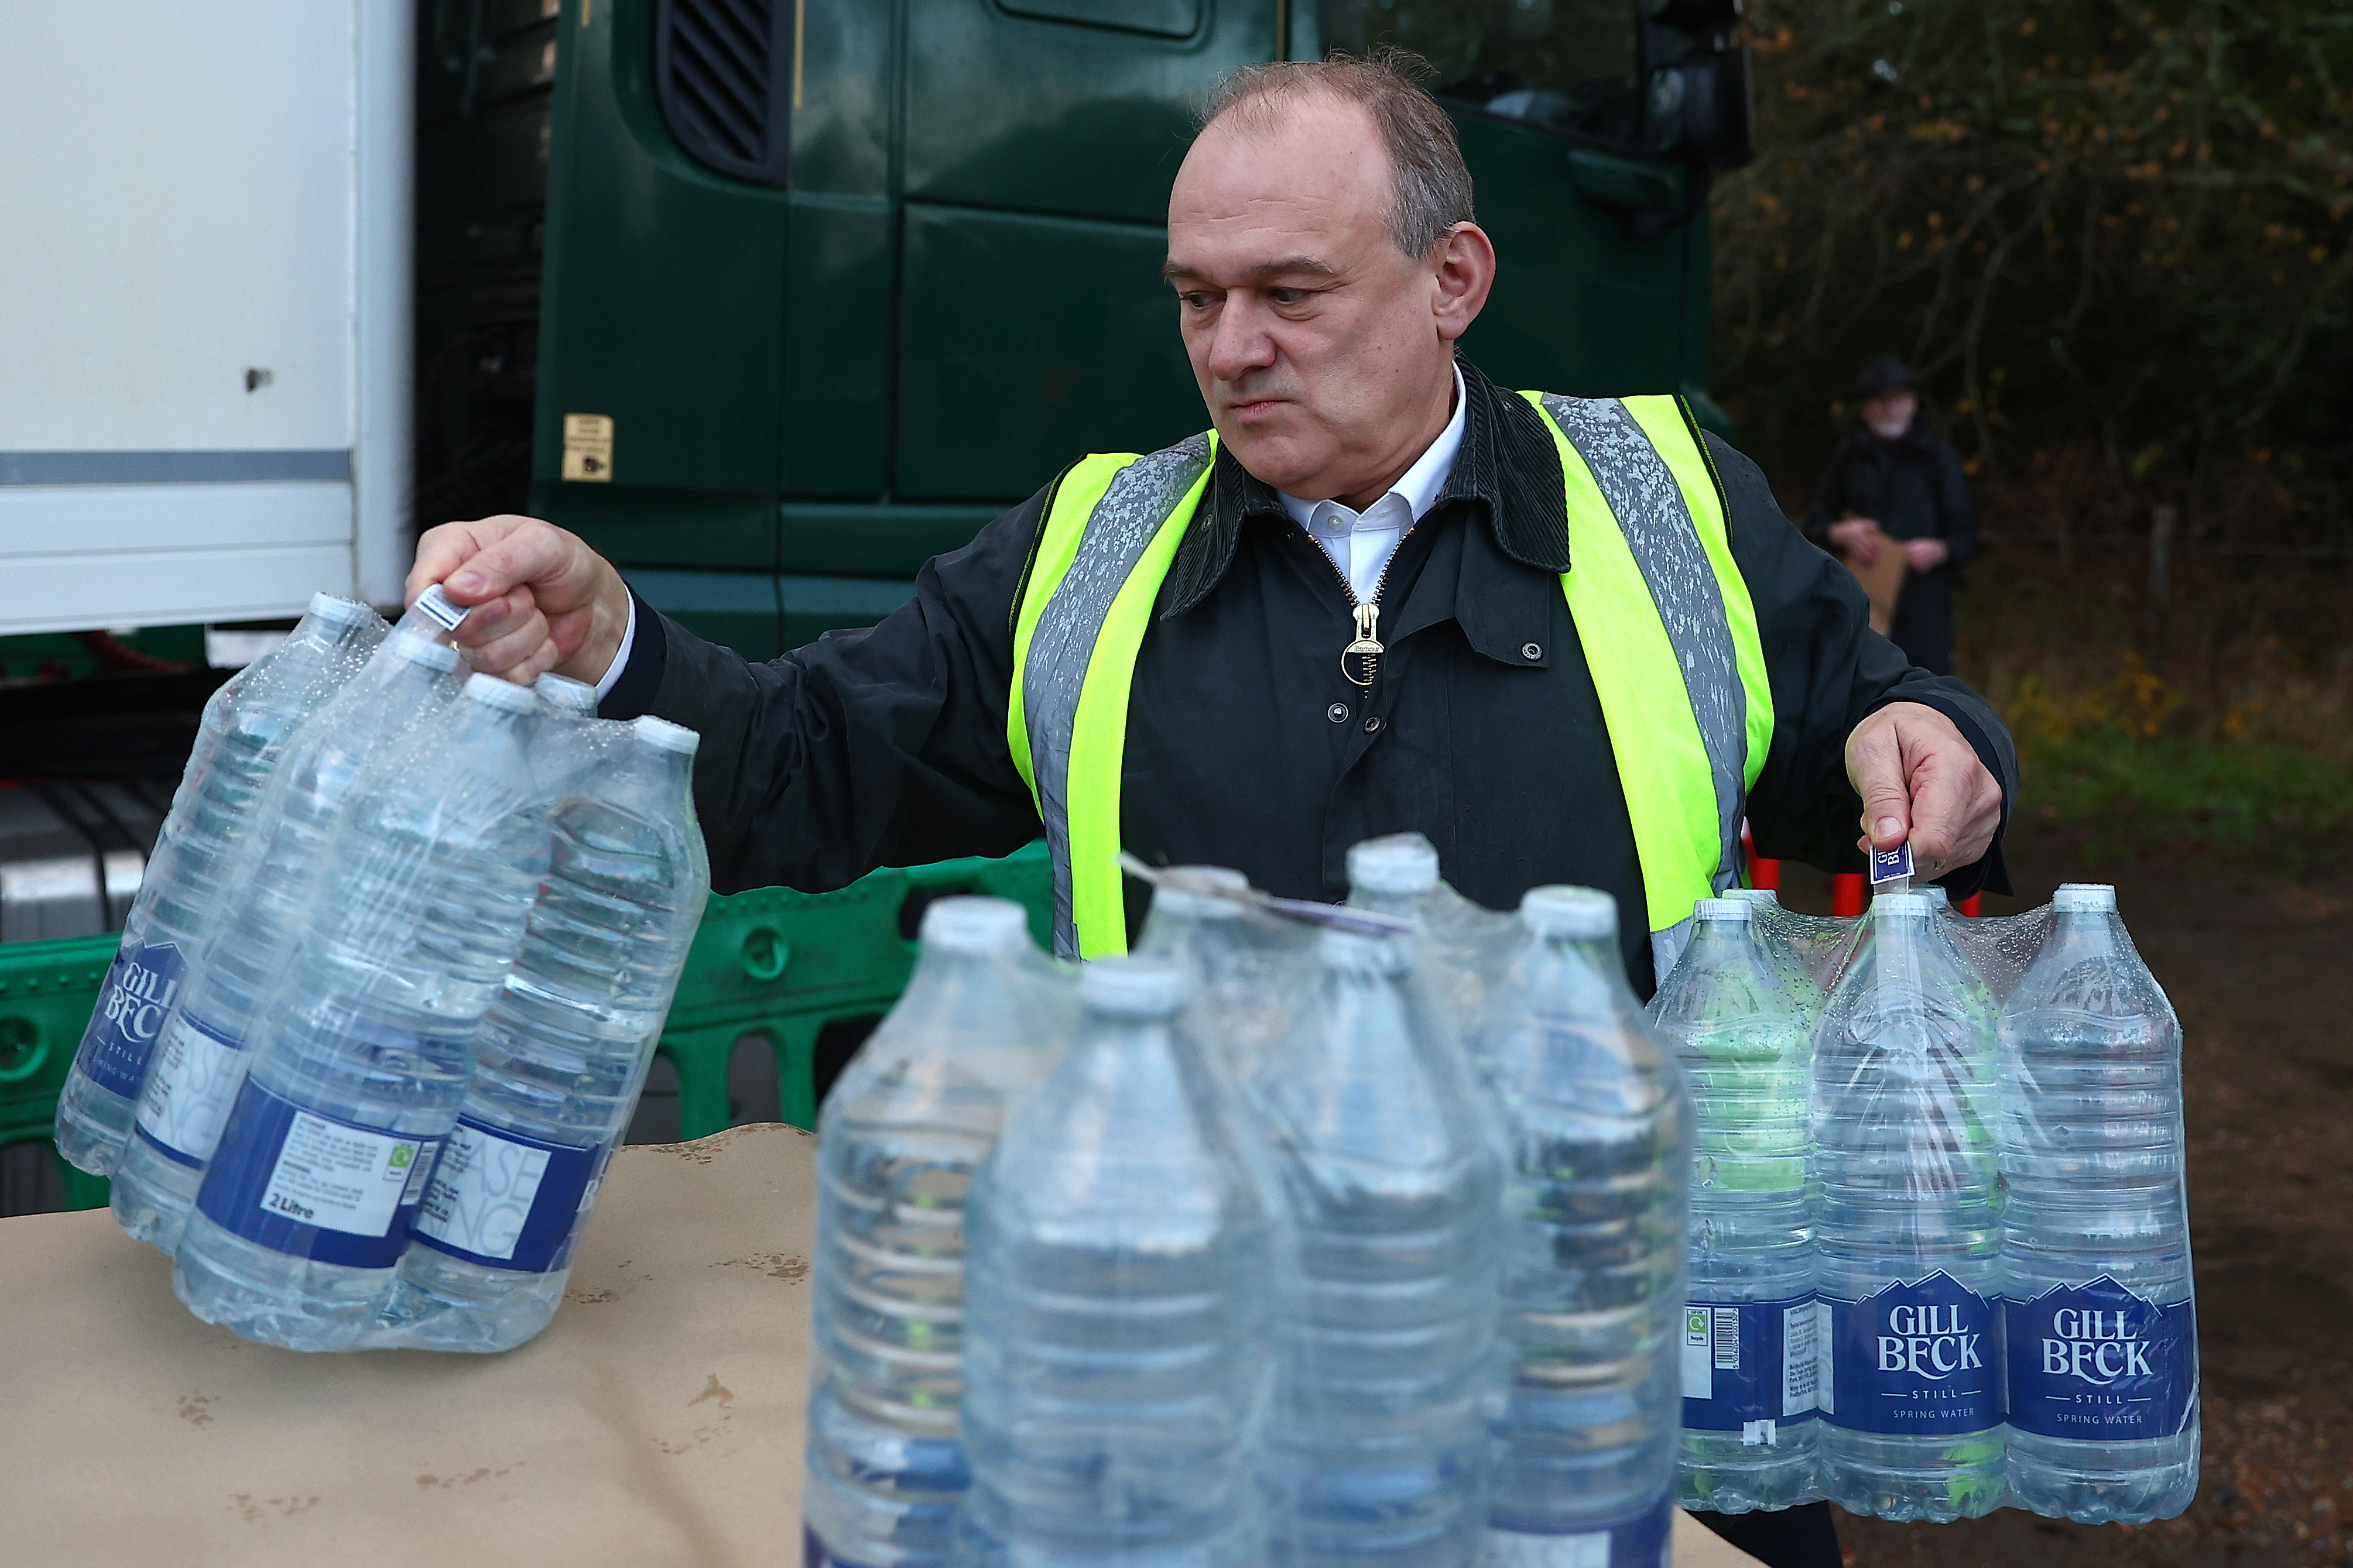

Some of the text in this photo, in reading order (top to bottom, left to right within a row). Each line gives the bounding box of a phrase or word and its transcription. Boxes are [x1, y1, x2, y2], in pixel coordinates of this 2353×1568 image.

[104, 984, 162, 1042] BEC
[269, 1193, 314, 1219] 2 Litre
[1889, 1304, 1969, 1336] GILL
[2053, 1308, 2138, 1340] GILL
[1876, 1333, 1983, 1380] BECK
[2042, 1338, 2153, 1385] BECK
[1912, 1389, 1957, 1399] STILL
[2075, 1394, 2122, 1404] STILL
[1893, 1407, 1974, 1419] SPRING WATER
[2056, 1413, 2143, 1424] SPRING WATER
